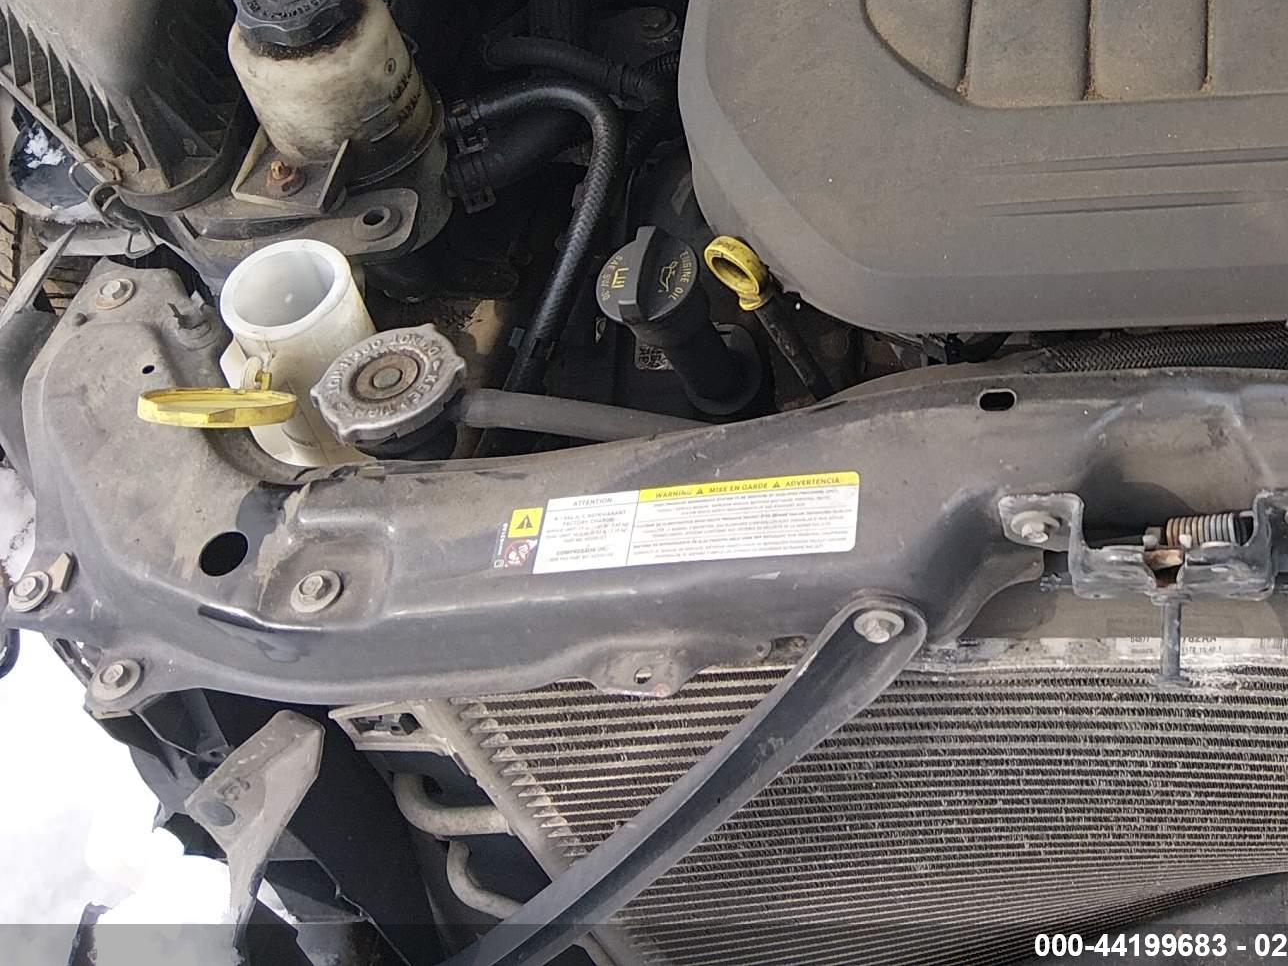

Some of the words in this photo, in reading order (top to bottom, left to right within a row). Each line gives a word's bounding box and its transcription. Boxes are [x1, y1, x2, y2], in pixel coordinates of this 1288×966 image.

[680, 252, 692, 283] ENGINE
[668, 287, 684, 300] OIL
[785, 477, 840, 487] ADVERTENCIA
